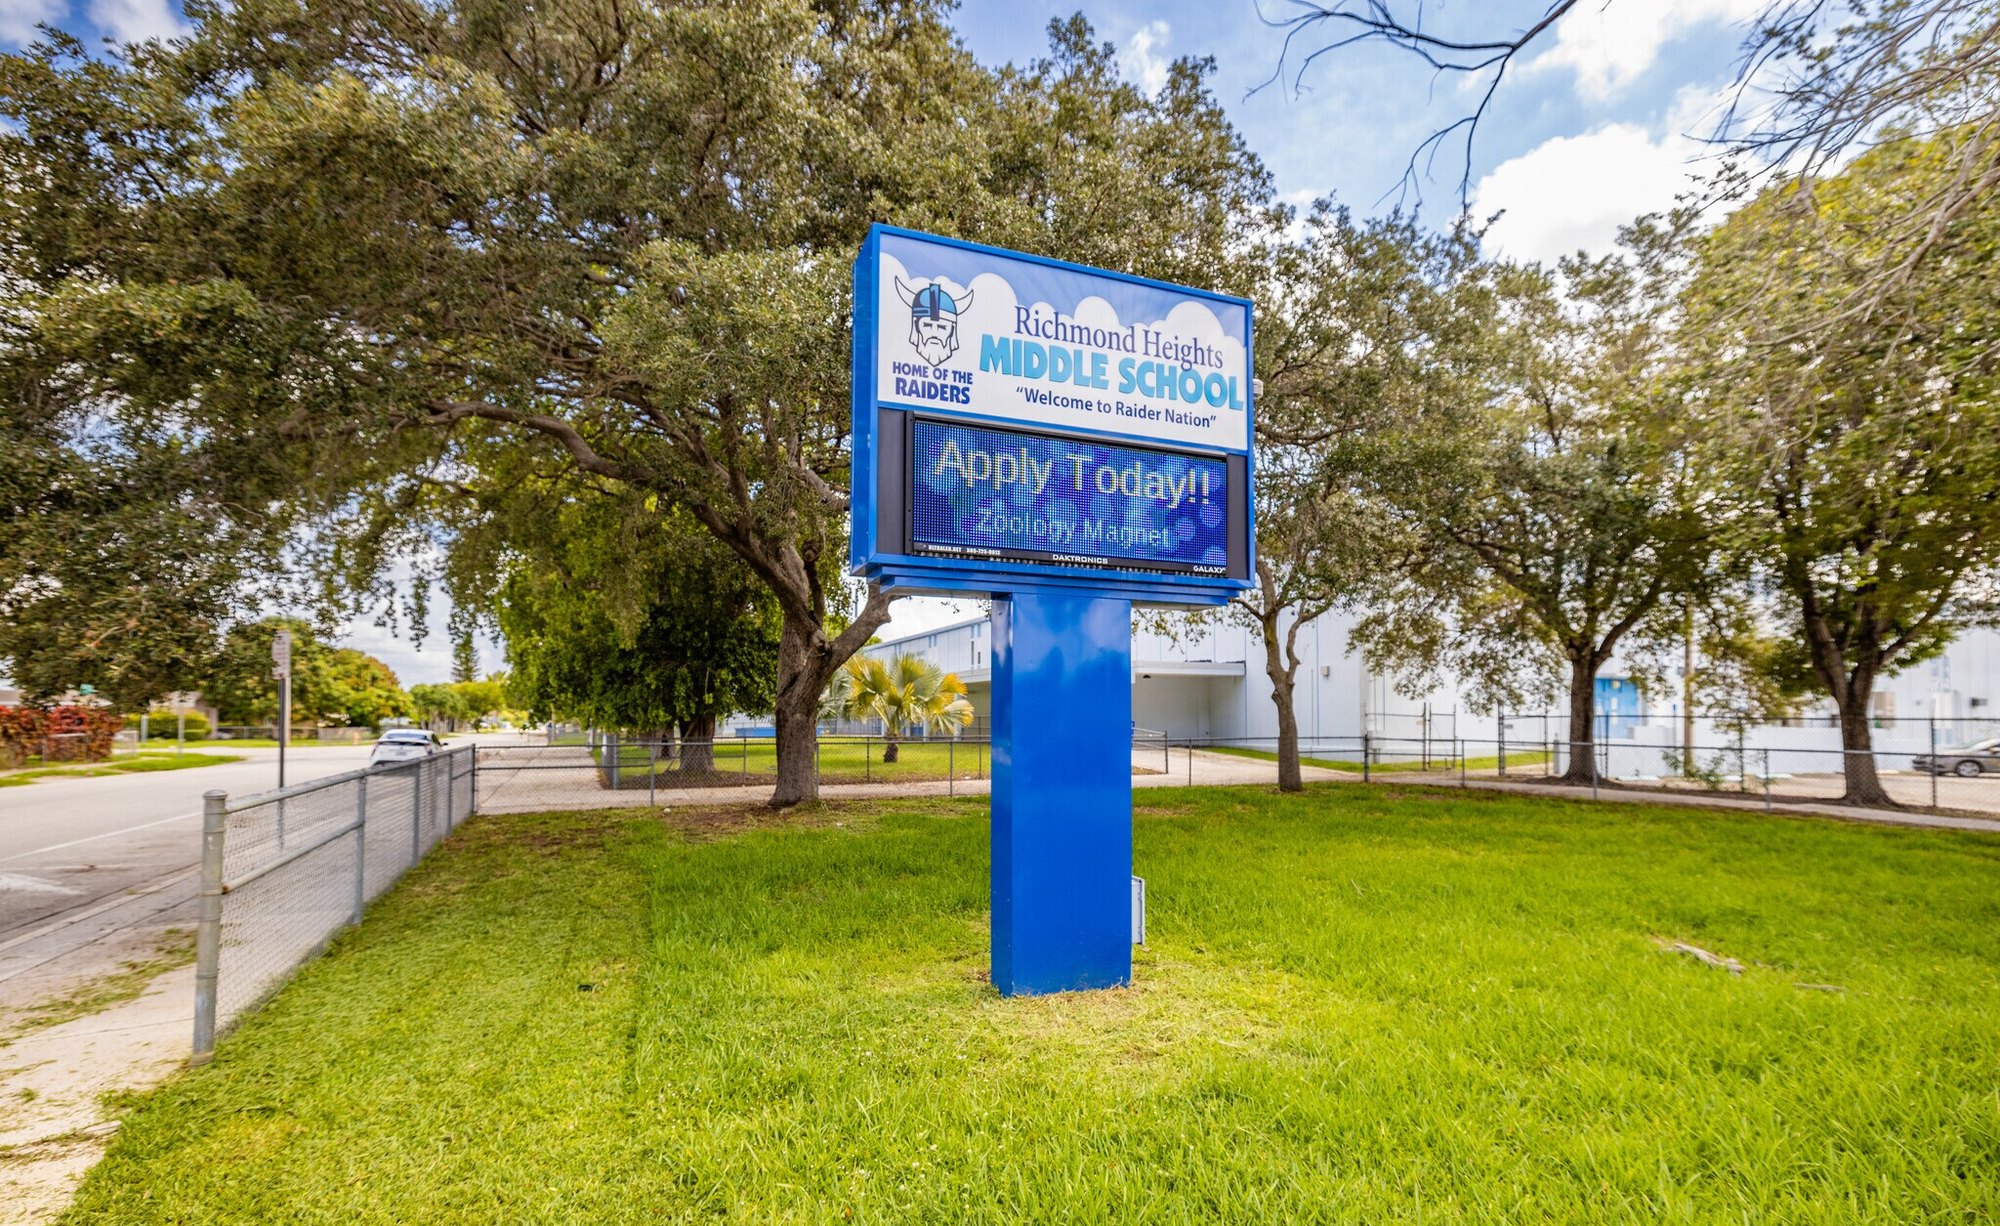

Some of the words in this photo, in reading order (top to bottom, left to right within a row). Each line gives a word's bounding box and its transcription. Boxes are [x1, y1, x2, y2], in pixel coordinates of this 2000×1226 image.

[1014, 305, 1136, 353] Richmond
[1142, 328, 1223, 372] Heights
[892, 361, 929, 378] HOME
[932, 367, 949, 381] OF
[952, 370, 974, 385] THE
[895, 377, 970, 405] RAIDERS
[979, 333, 1110, 391] MIDDLE
[1118, 357, 1244, 411] SCHOOL
[1016, 386, 1093, 411] “Welcome
[1097, 399, 1112, 414] to
[1115, 401, 1161, 421] Raider
[1165, 408, 1217, 428] Nation”
[933, 439, 1053, 495] Apply
[1065, 452, 1210, 509] Today!!
[976, 506, 1075, 544] Zoology
[1084, 518, 1169, 549] Magnet
[1052, 554, 1108, 565] DAKTRONICS
